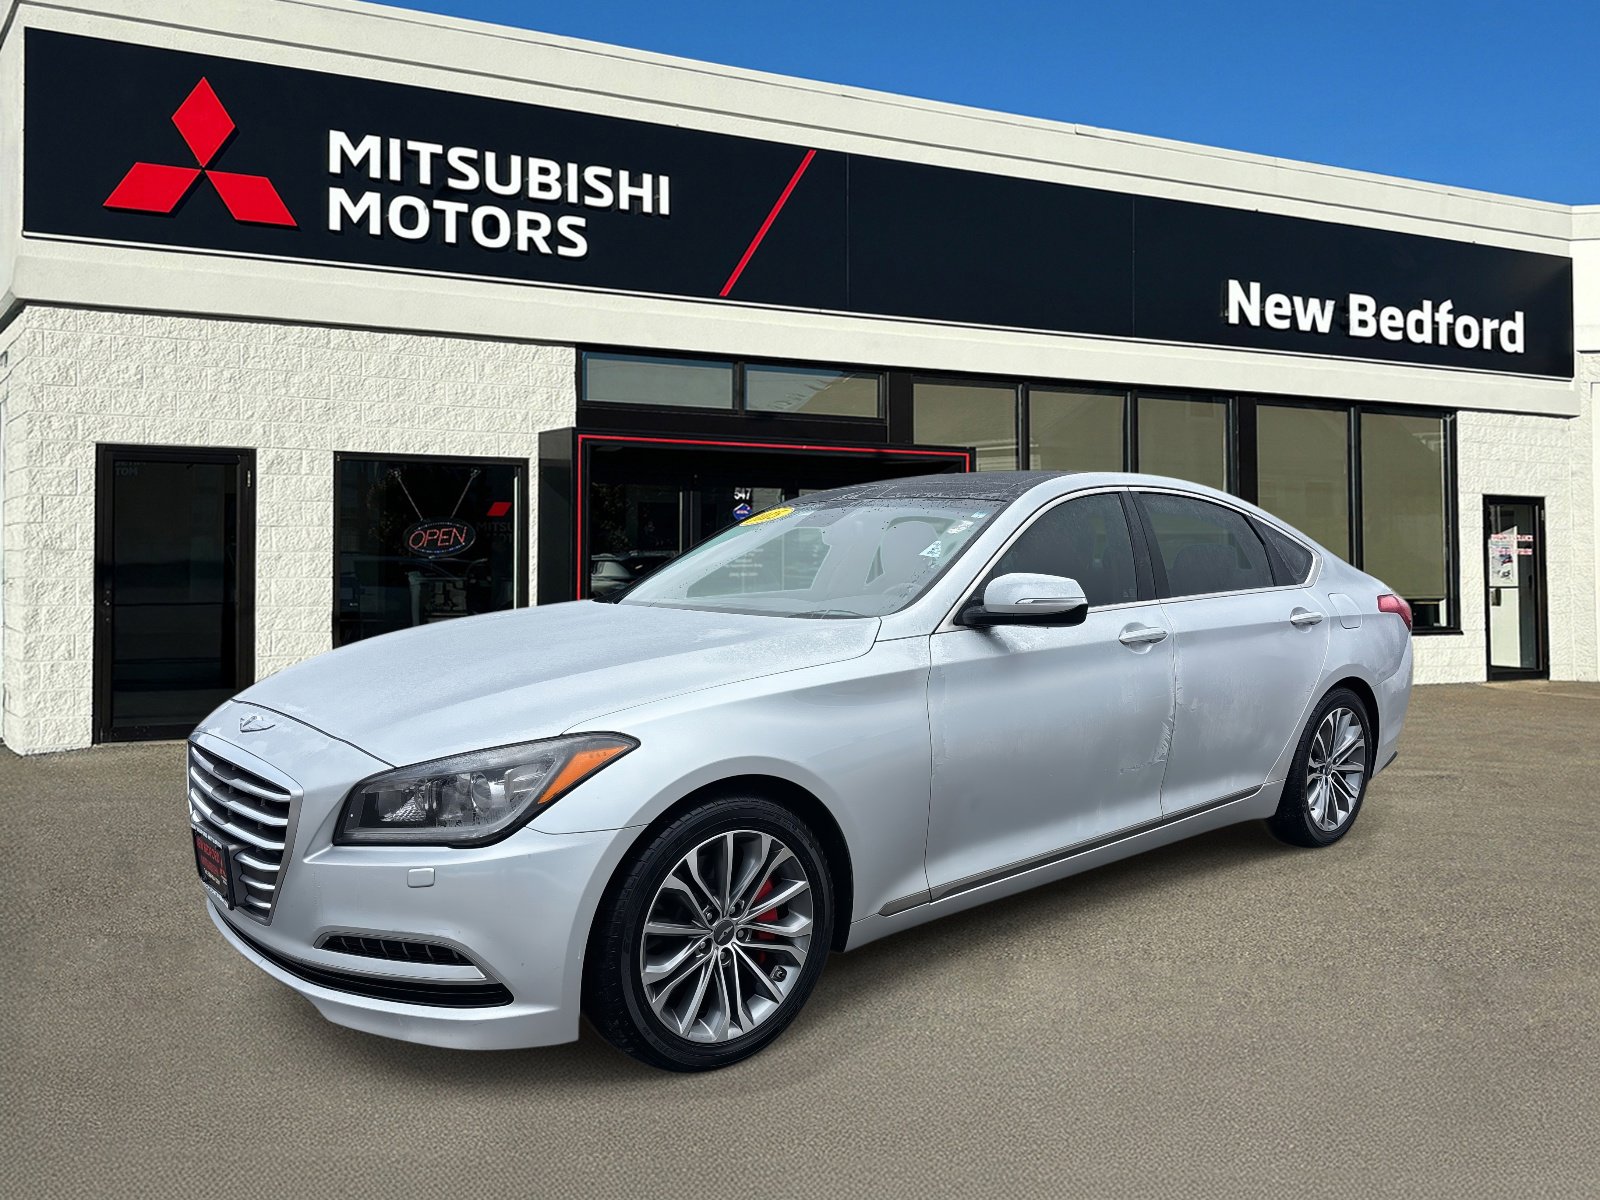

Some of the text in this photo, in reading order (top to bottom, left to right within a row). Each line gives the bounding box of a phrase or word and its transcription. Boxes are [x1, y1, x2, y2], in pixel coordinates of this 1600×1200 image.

[328, 129, 670, 216] MITSUBISHI
[328, 186, 588, 258] MOTORS
[1228, 279, 1525, 353] New Bedford
[733, 487, 751, 500] 547
[408, 526, 467, 549] OPEN
